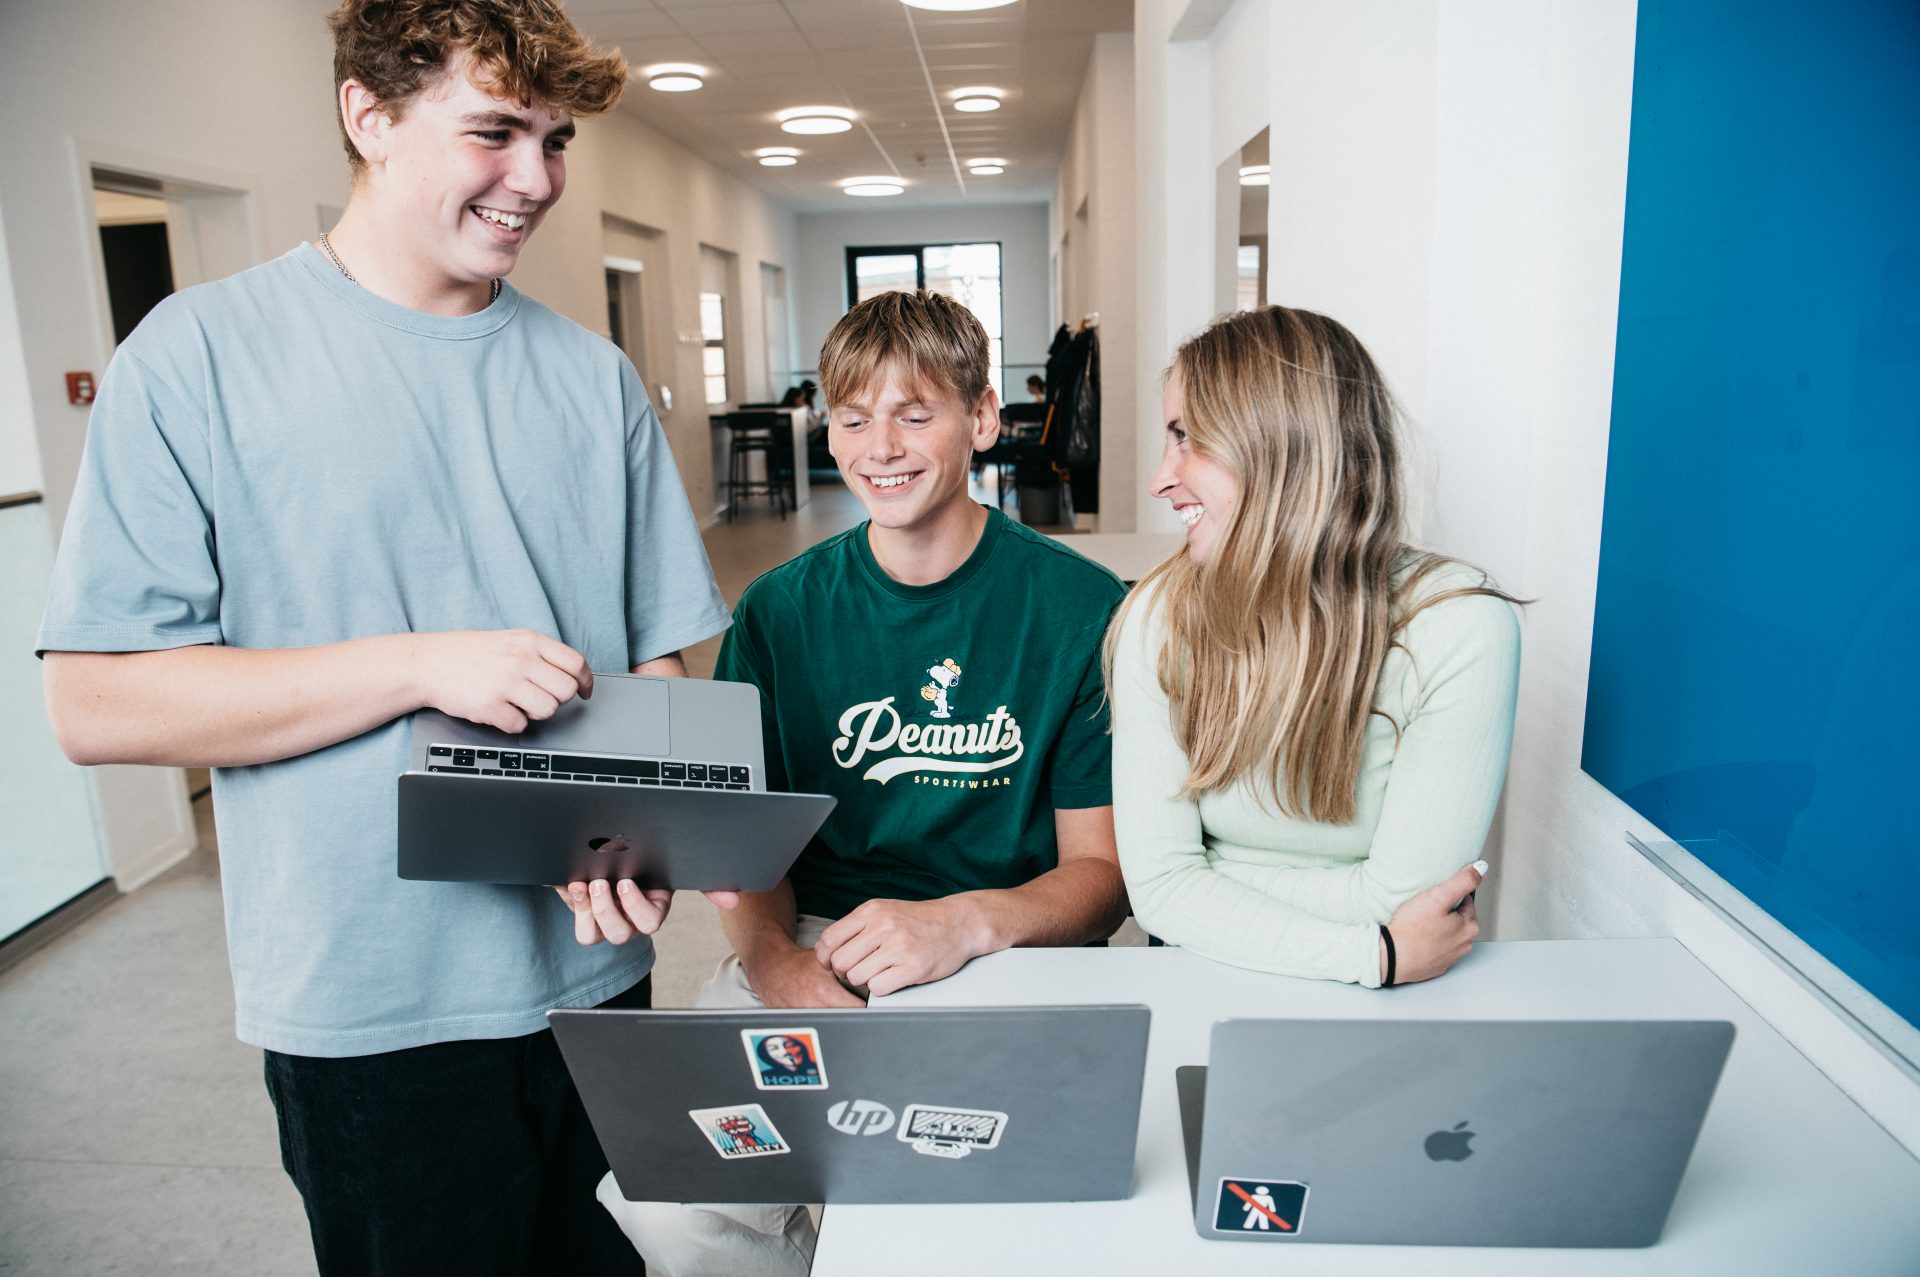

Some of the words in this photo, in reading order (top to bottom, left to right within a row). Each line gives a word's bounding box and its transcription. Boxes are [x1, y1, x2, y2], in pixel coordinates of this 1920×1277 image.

[832, 696, 1023, 769] Peanuts
[914, 775, 1011, 789] SPORTSWEAR
[764, 1075, 819, 1085] HOPE
[836, 1099, 889, 1136] hp
[725, 1143, 779, 1155] LIBERTY
